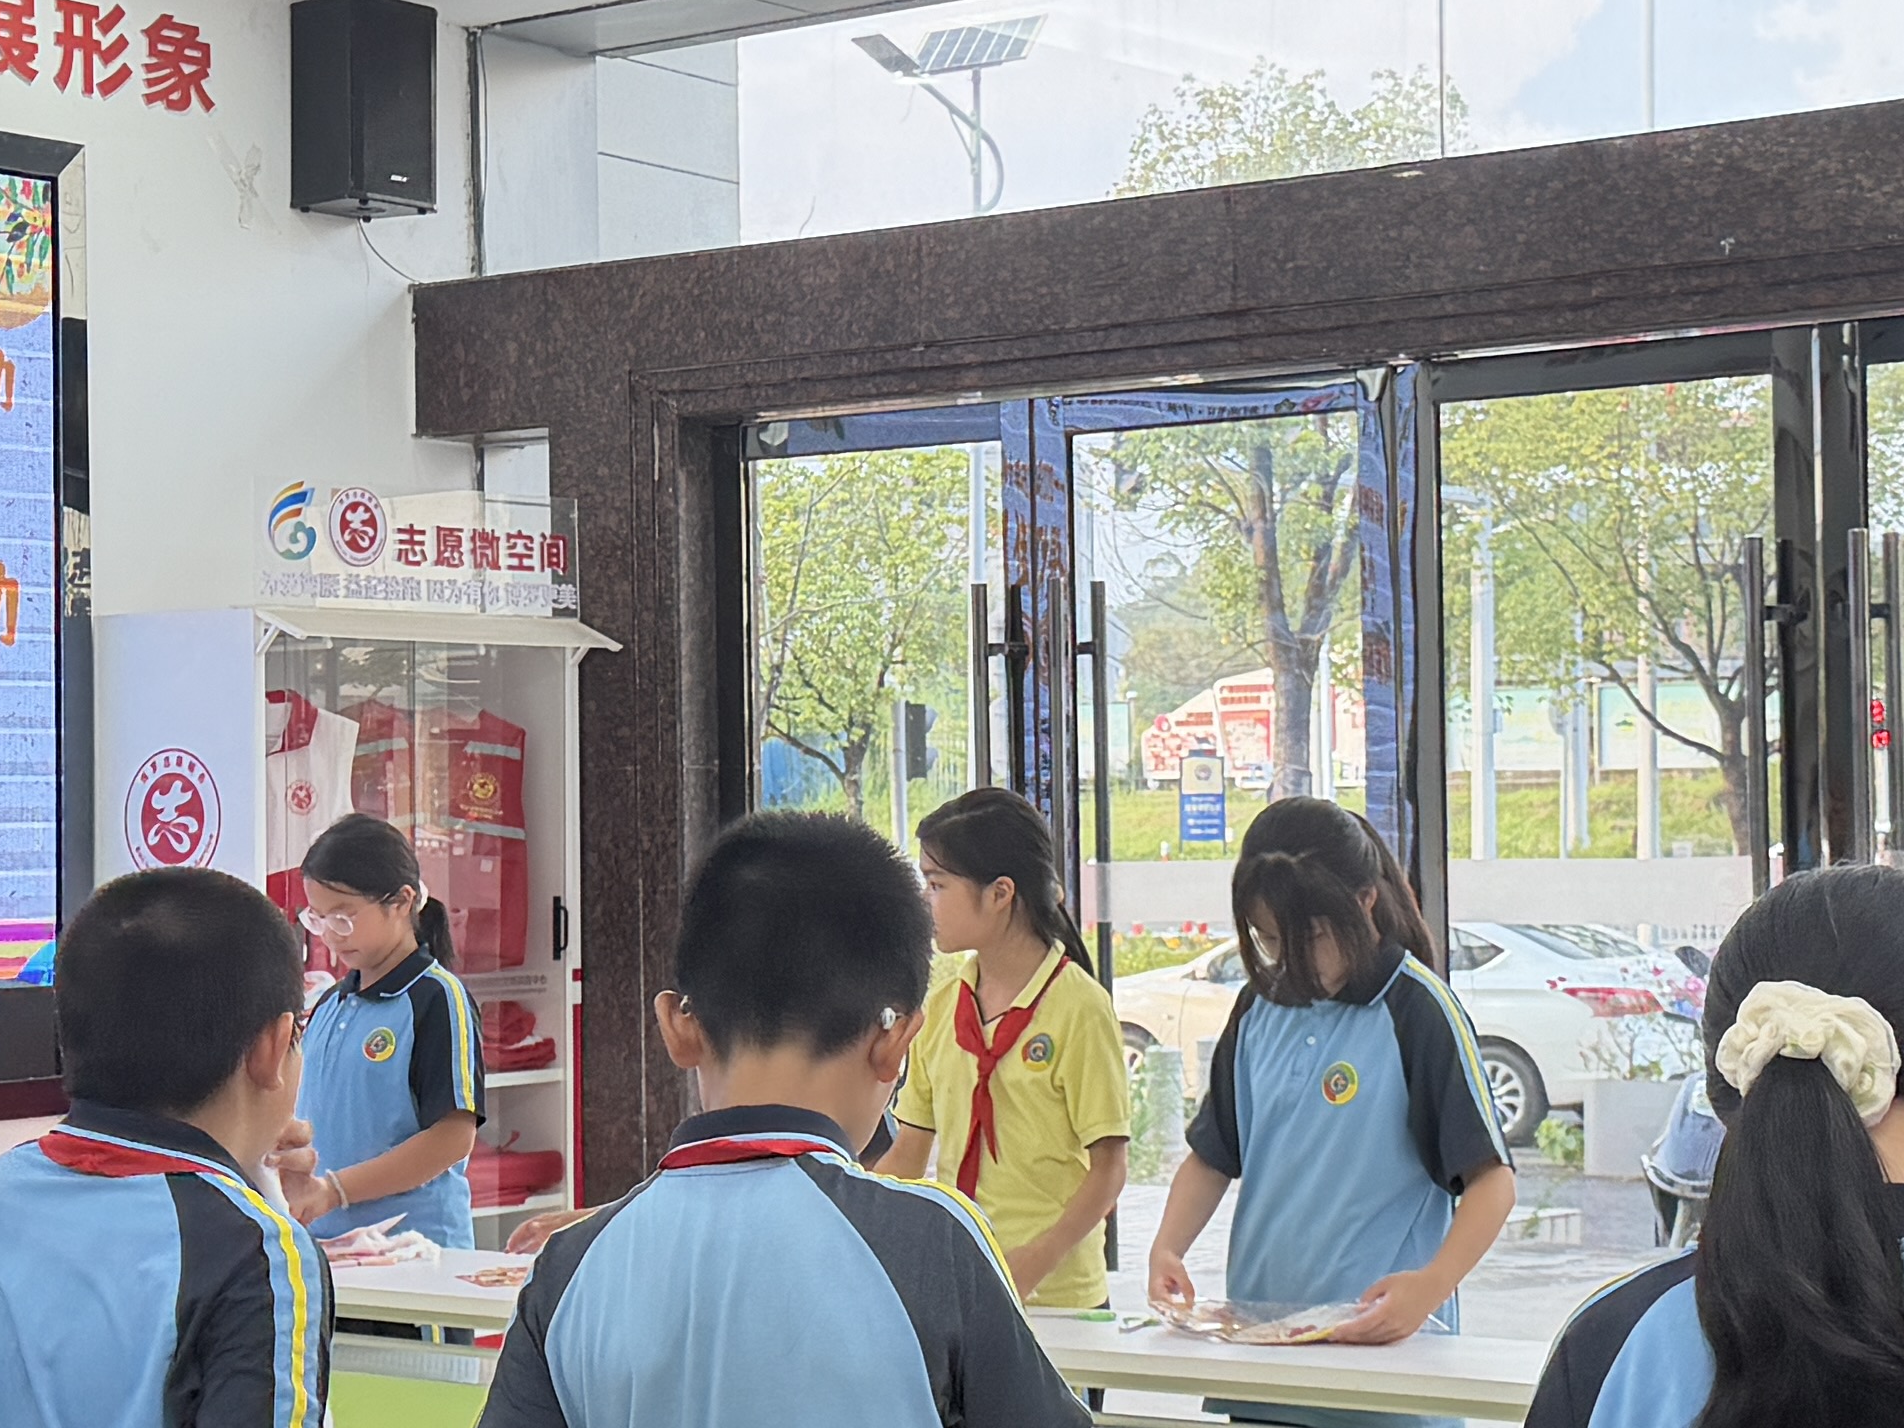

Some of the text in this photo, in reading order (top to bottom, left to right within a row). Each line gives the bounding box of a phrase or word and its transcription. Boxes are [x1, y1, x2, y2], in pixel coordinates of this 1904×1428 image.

[393, 523, 570, 575] 志愿微空间
